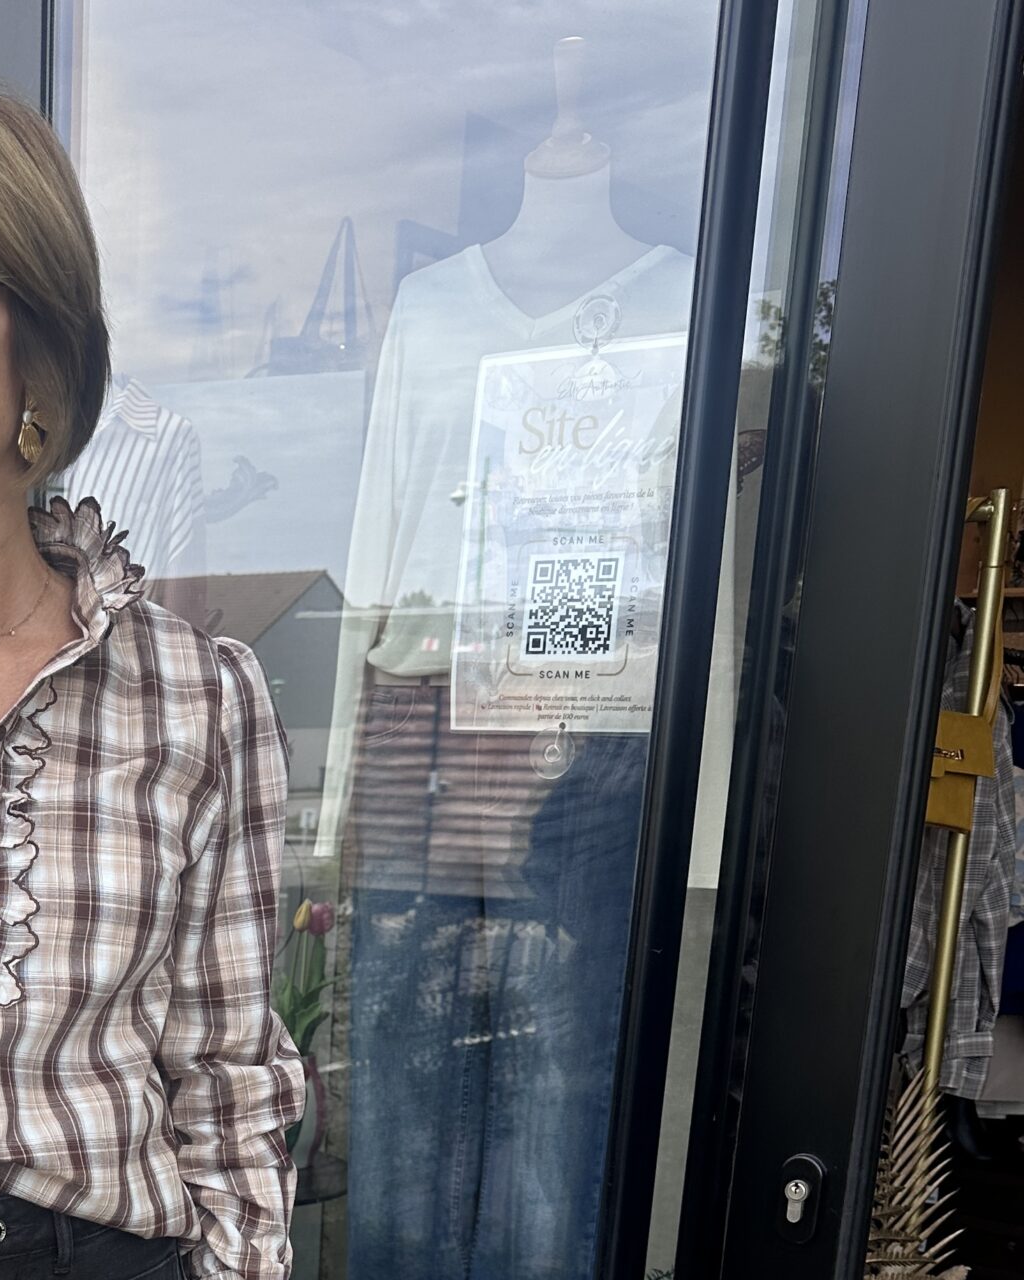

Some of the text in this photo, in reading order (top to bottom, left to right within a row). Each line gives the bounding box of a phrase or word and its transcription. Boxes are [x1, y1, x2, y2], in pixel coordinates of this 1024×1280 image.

[518, 405, 600, 455] Site
[552, 534, 605, 546] SCAN ME
[505, 578, 519, 638] SCAN ME
[624, 576, 640, 637] SCAN ME
[538, 669, 592, 679] SCAN ME
